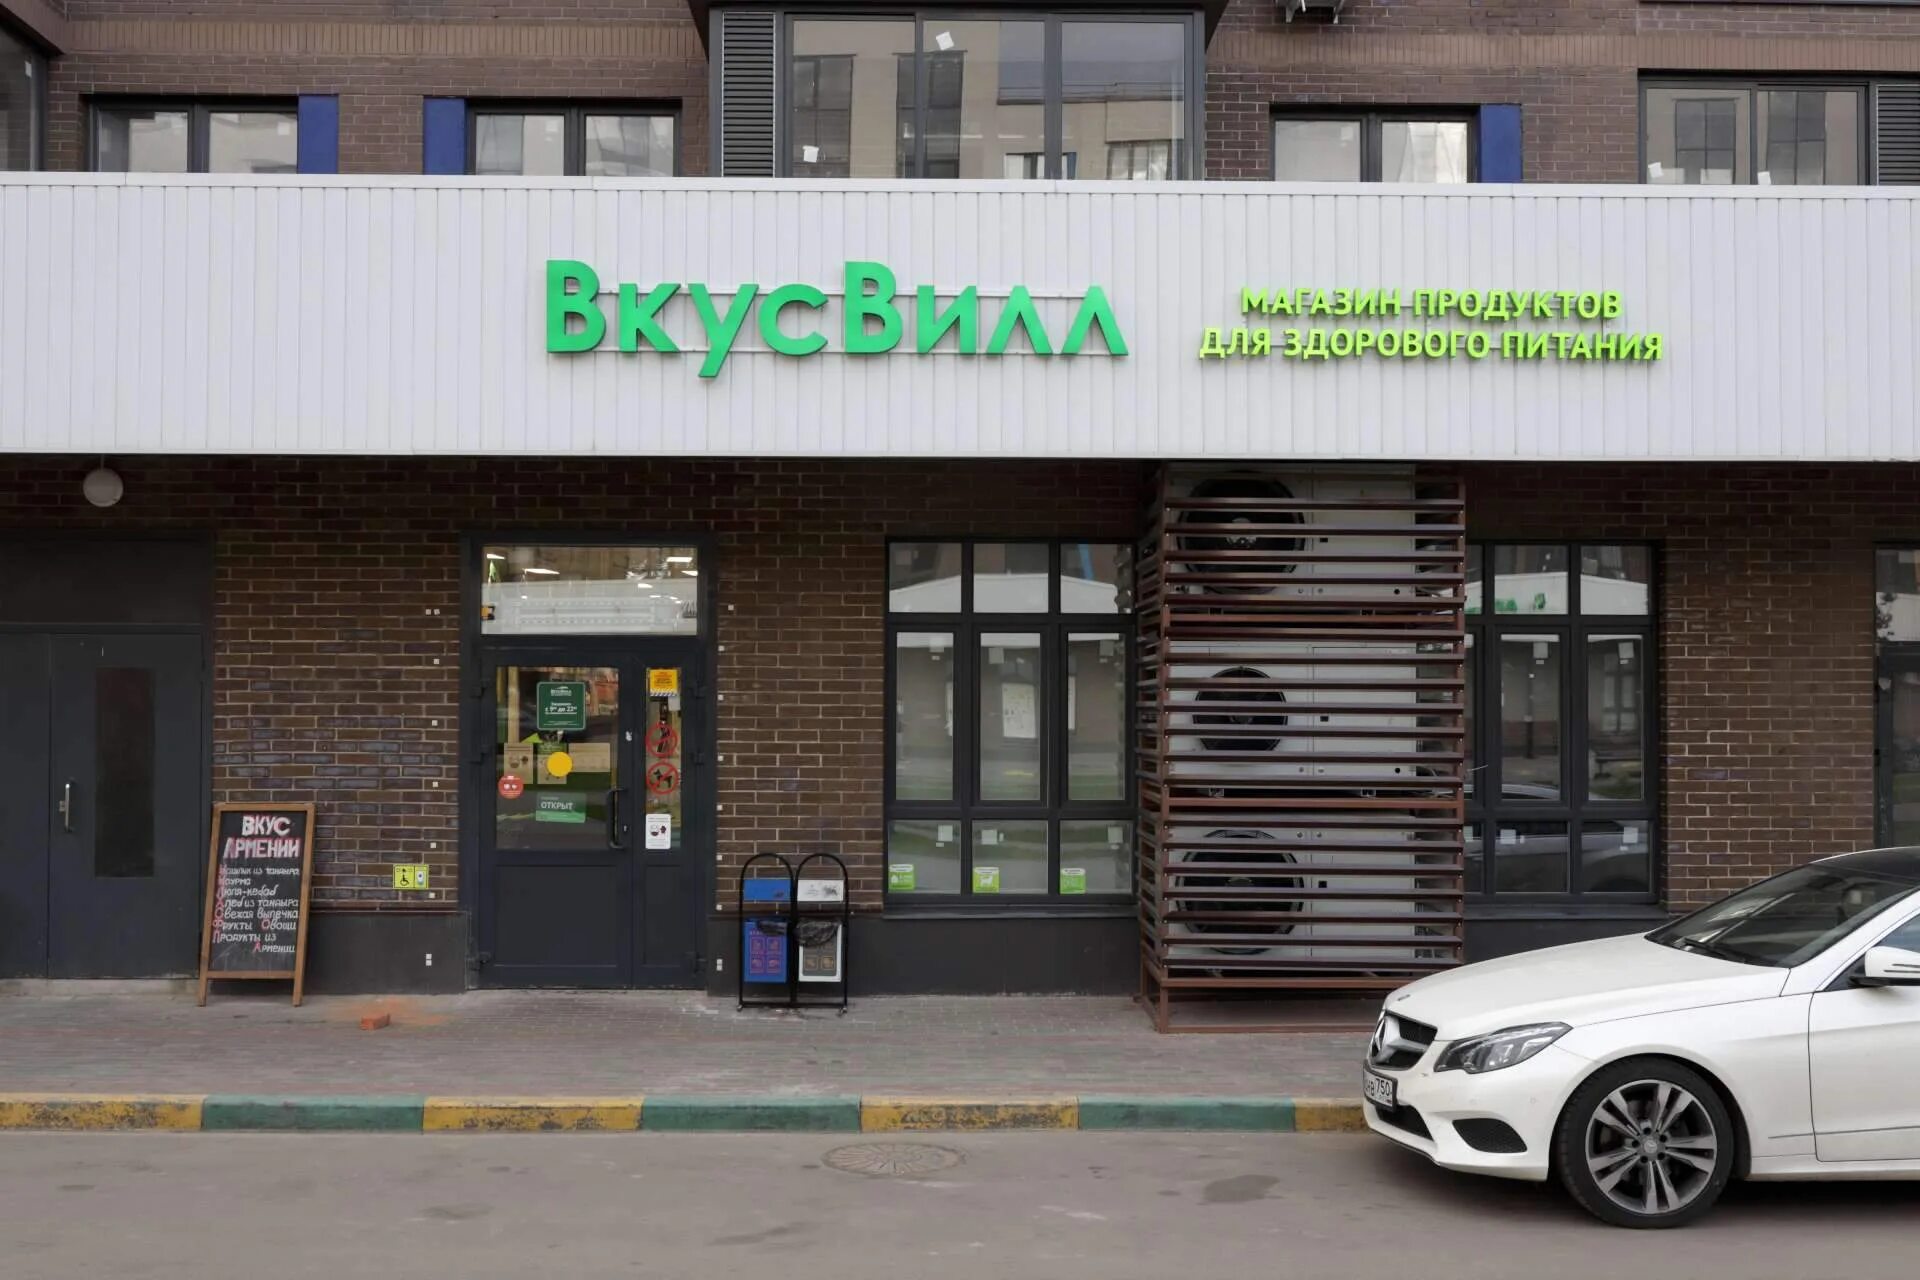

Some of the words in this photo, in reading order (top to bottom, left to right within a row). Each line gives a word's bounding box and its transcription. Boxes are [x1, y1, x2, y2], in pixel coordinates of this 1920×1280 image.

[1241, 287, 1402, 316] МАГАЗИН
[1413, 290, 1623, 320] ПРОДУКТОВ
[546, 260, 1128, 378] ВкусВилл
[1199, 327, 1272, 360] ДЛЯ
[1283, 328, 1490, 360] ЗДОРОВОГО
[1501, 331, 1664, 362] ПИТАНИЯ
[242, 815, 291, 836] ВКУС
[223, 837, 300, 858] АРМЕНИИ
[214, 907, 254, 920] Свежая
[257, 907, 299, 919] выпечка
[211, 919, 253, 930] Фрукты
[261, 918, 297, 930] Овощи
[212, 929, 261, 944] Продукты
[264, 933, 277, 942] из
[252, 940, 296, 954] Армении
[1375, 1078, 1391, 1096] 750
